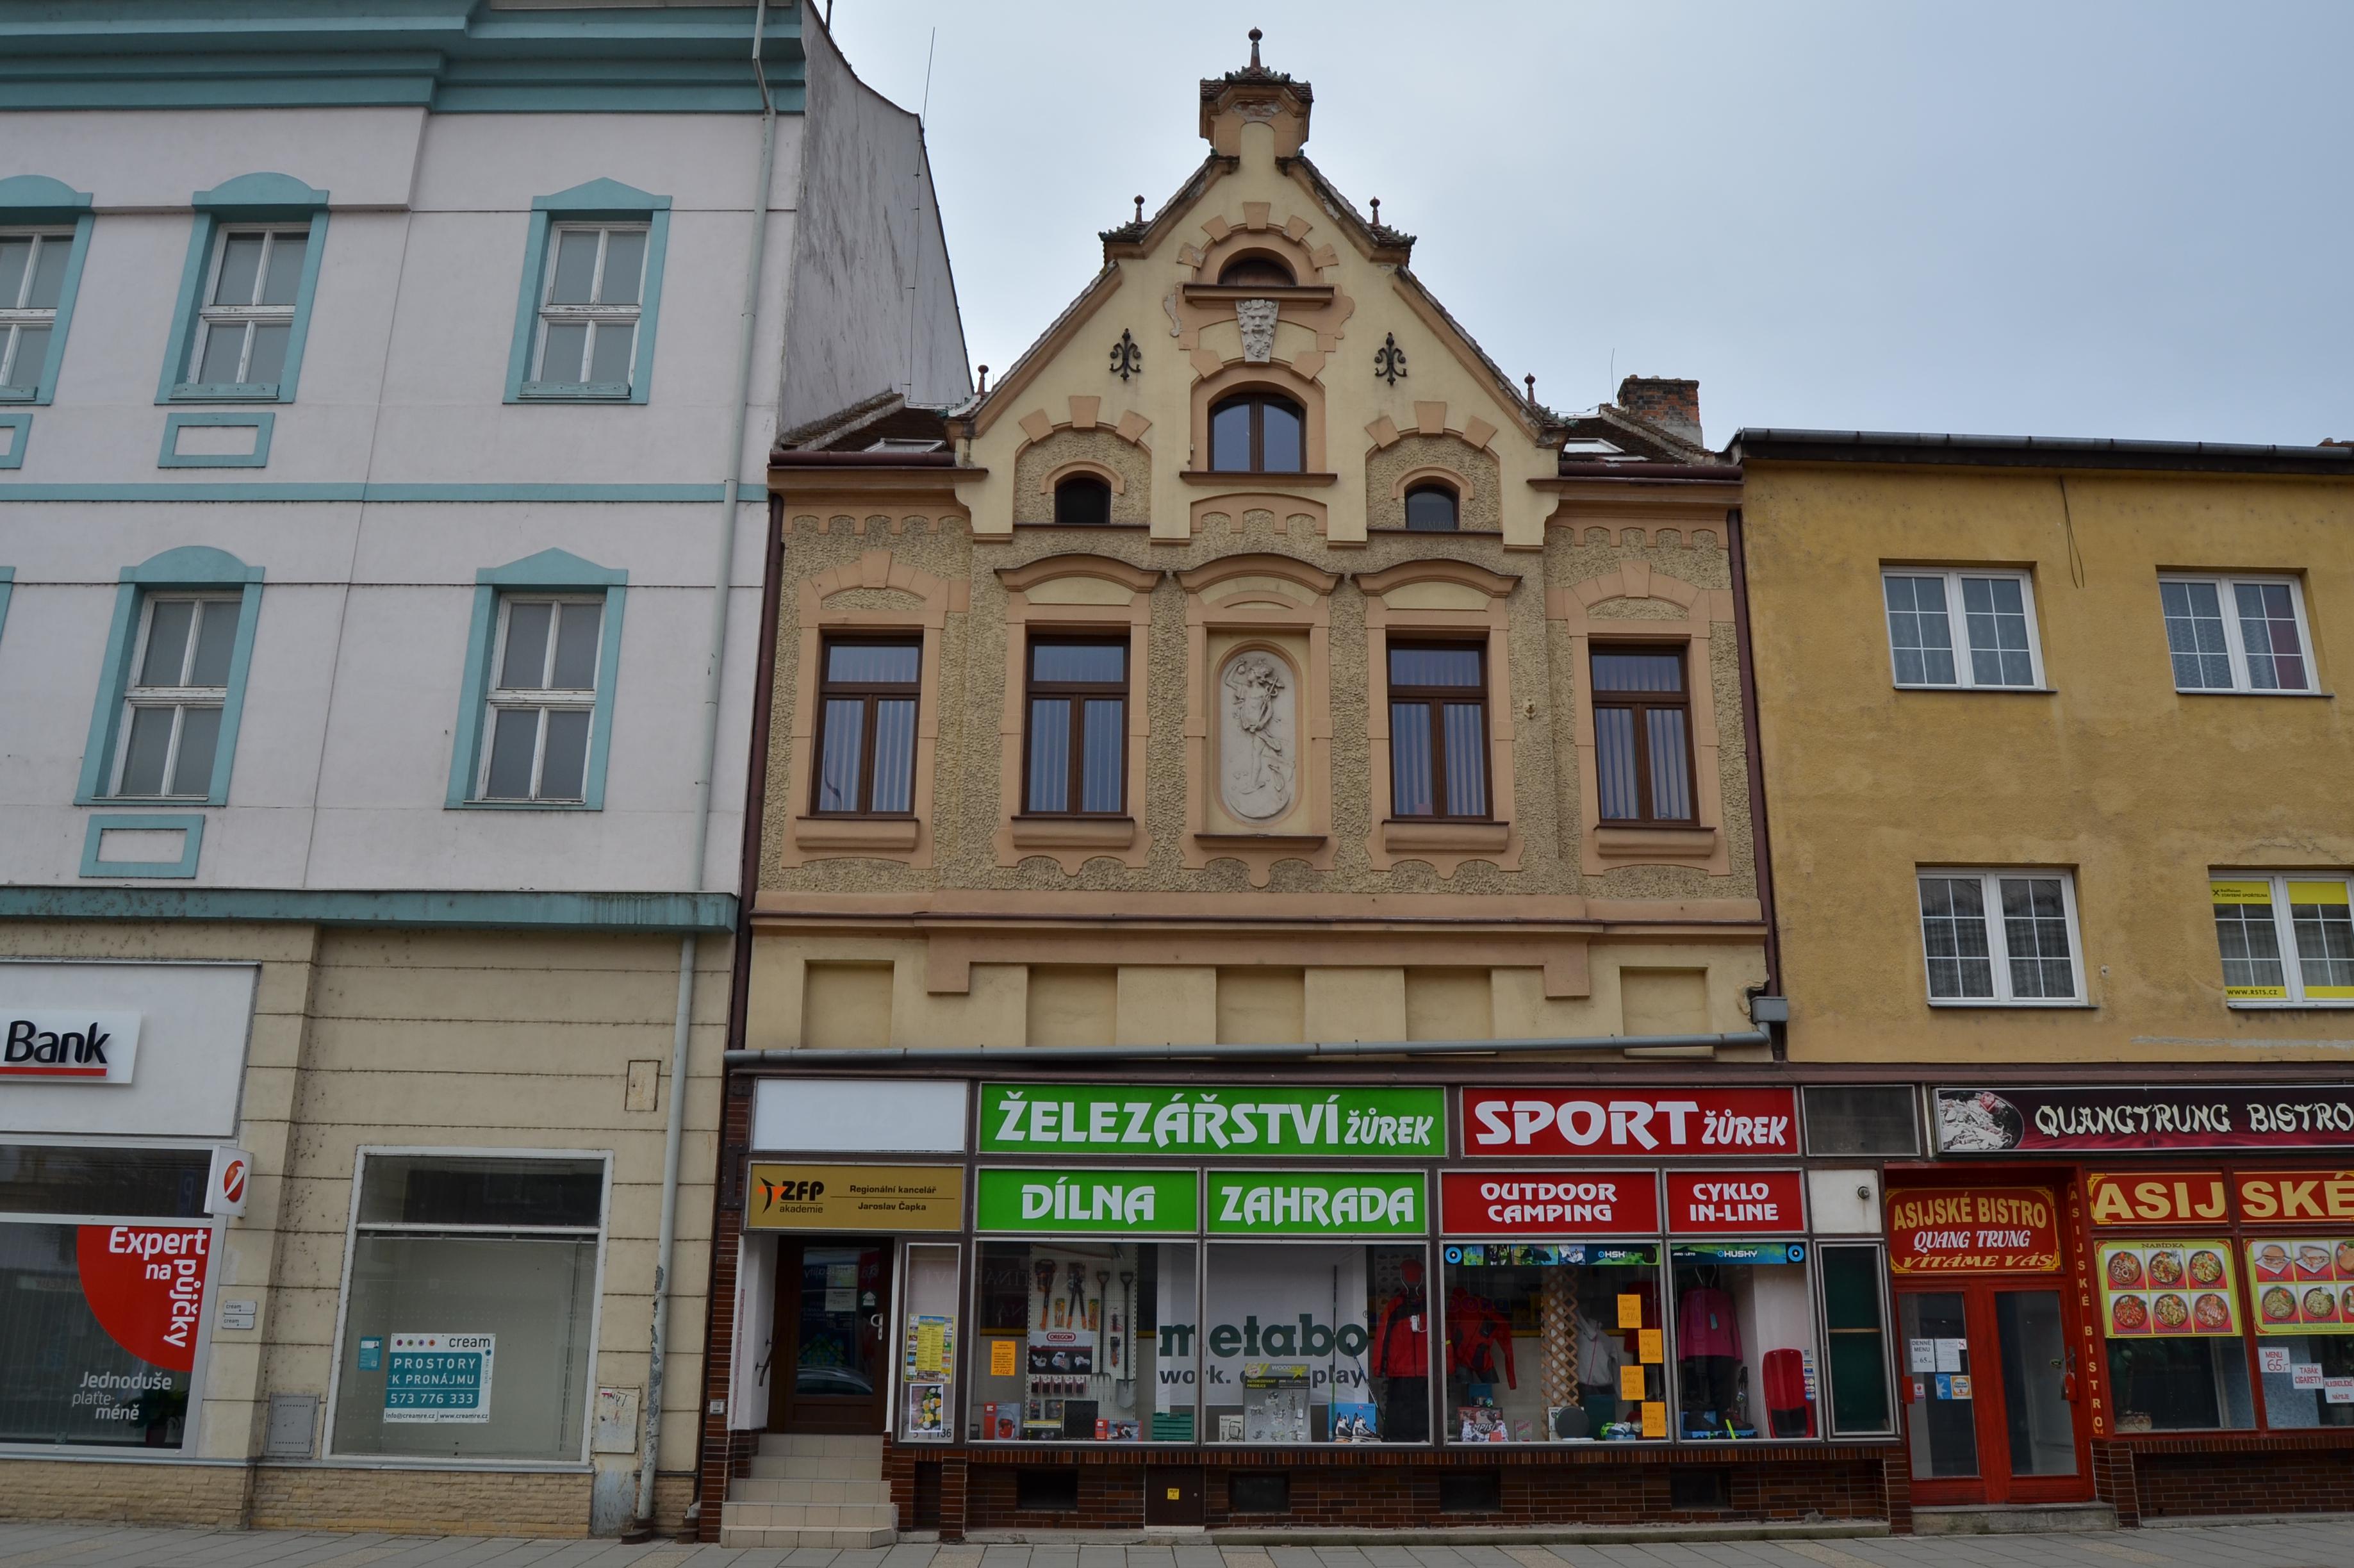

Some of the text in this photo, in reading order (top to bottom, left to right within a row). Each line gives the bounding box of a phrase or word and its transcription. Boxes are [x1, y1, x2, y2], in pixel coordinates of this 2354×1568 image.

[4, 1020, 111, 1064] Bank
[995, 1091, 1435, 1149] ŽELEZÁŘSTVÍ ŽŮREK
[1475, 1100, 1789, 1151] SPORT ŽŮREK
[2246, 1102, 2354, 1132] BISTRO
[780, 1180, 825, 1201] ZFP
[850, 1185, 937, 1194] Regionální kancelář
[1481, 1183, 1618, 1203] OUTDOOR
[1693, 1183, 1769, 1202] CYKLO
[779, 1205, 823, 1214] akademie
[858, 1200, 926, 1212] Jaroslav Čapka
[1021, 1176, 1155, 1225] DÍLNA
[1220, 1186, 1415, 1226] ZAHRADA
[1488, 1205, 1612, 1224] CAMPING
[1690, 1203, 1779, 1222] IN-LINE
[1894, 1191, 2047, 1231] ASIJSKÉ BISTRO
[109, 1226, 208, 1261] Expert
[1914, 1230, 2031, 1253] QUANG TRUNG
[1724, 1250, 1757, 1258] HUSKY
[1903, 1251, 2054, 1268] VÍTÁME VÁS
[145, 1264, 172, 1280] na
[163, 1259, 201, 1348] půjčky
[449, 1337, 491, 1348] cream
[1159, 1313, 1369, 1358] metabo
[393, 1358, 476, 1369] PROSTORY
[2299, 1365, 2318, 1374] TABÁK
[79, 1371, 172, 1390] Jednoduše
[391, 1373, 474, 1385] K PRONÁJMU
[1160, 1365, 1231, 1384] wok.
[390, 1394, 473, 1404] 573 776 333
[95, 1403, 140, 1421] méně
